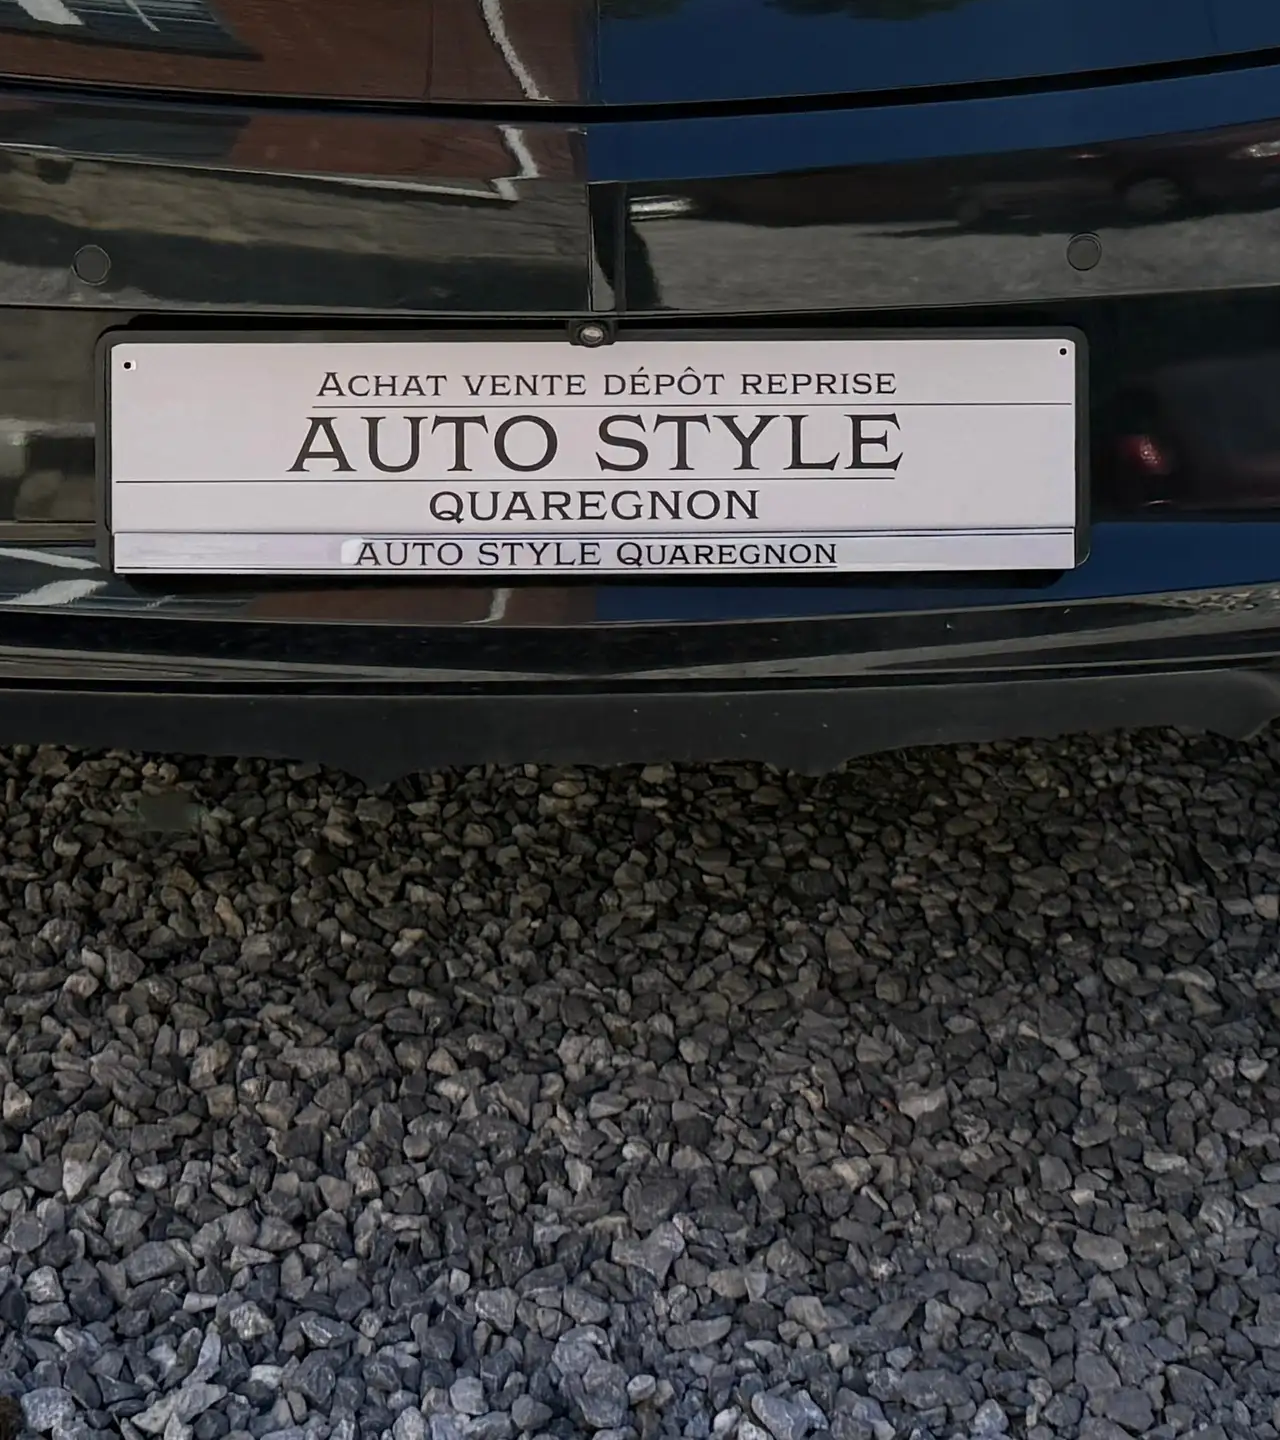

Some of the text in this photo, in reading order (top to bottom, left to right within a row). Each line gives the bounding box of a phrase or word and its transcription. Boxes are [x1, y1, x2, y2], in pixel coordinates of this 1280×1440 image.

[316, 366, 897, 397] ACHAT VENTE DÉPÔT REPRISE
[286, 412, 904, 473] AUTO STYLE
[429, 489, 760, 524] QUAREGNON
[354, 541, 463, 567] AUTO
[477, 541, 602, 567] STYLE
